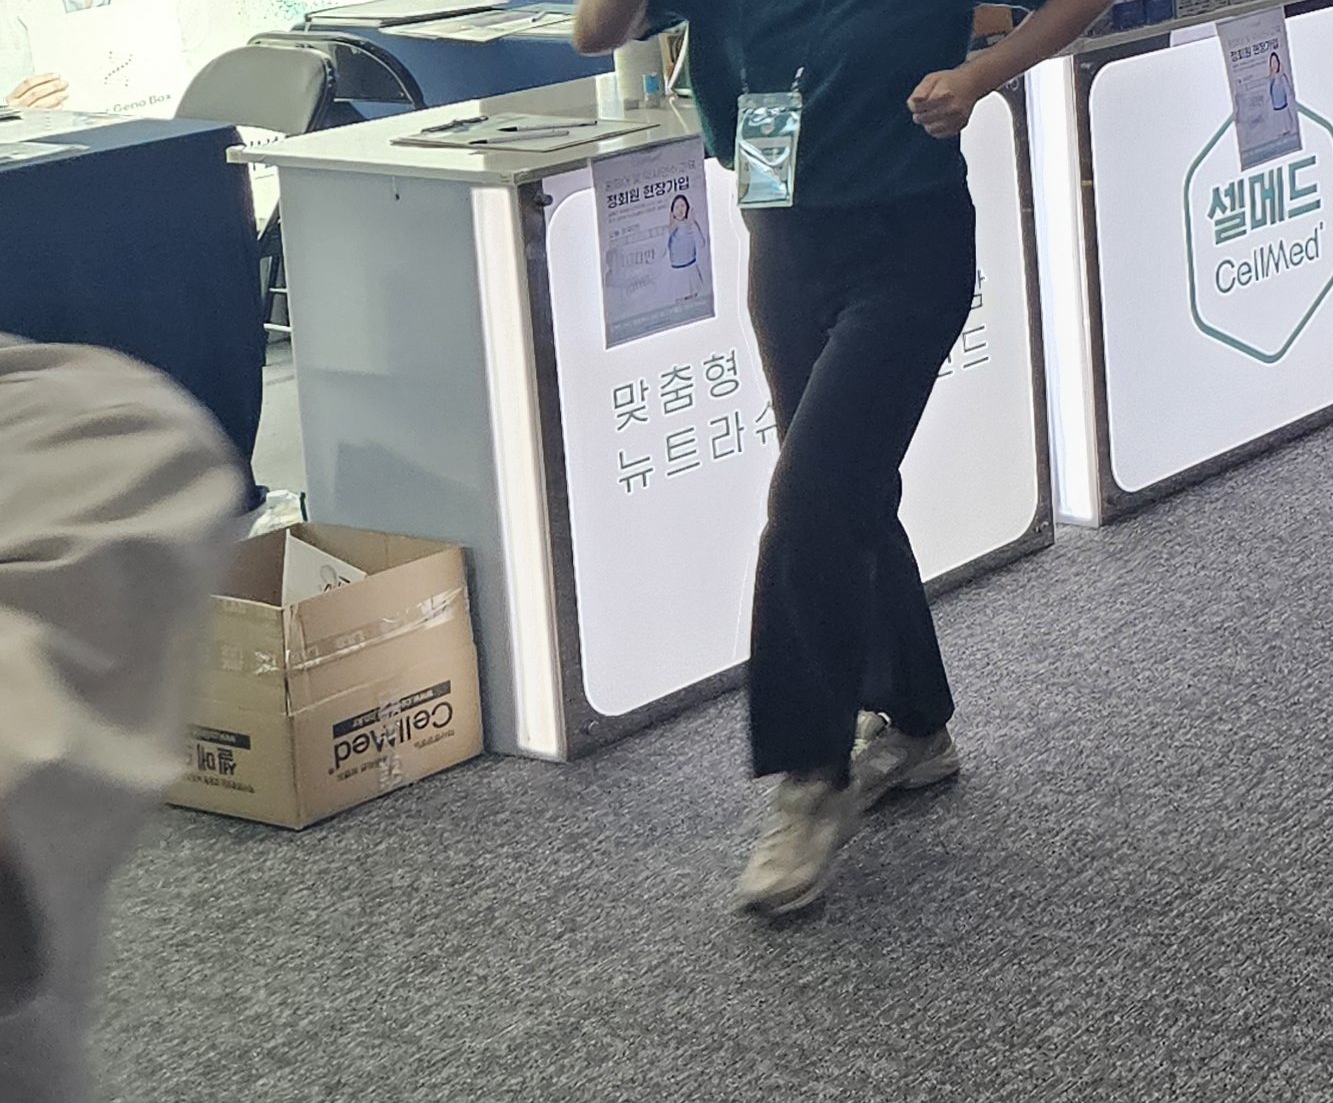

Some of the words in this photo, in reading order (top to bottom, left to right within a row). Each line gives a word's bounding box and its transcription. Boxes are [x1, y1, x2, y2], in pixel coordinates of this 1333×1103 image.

[113, 100, 147, 114] Geno
[606, 187, 641, 209] 정회원
[643, 175, 690, 200] 현장가입
[1207, 154, 1322, 246] 셀메드
[1215, 223, 1322, 294] CellMed
[612, 349, 740, 432] 맞춤형
